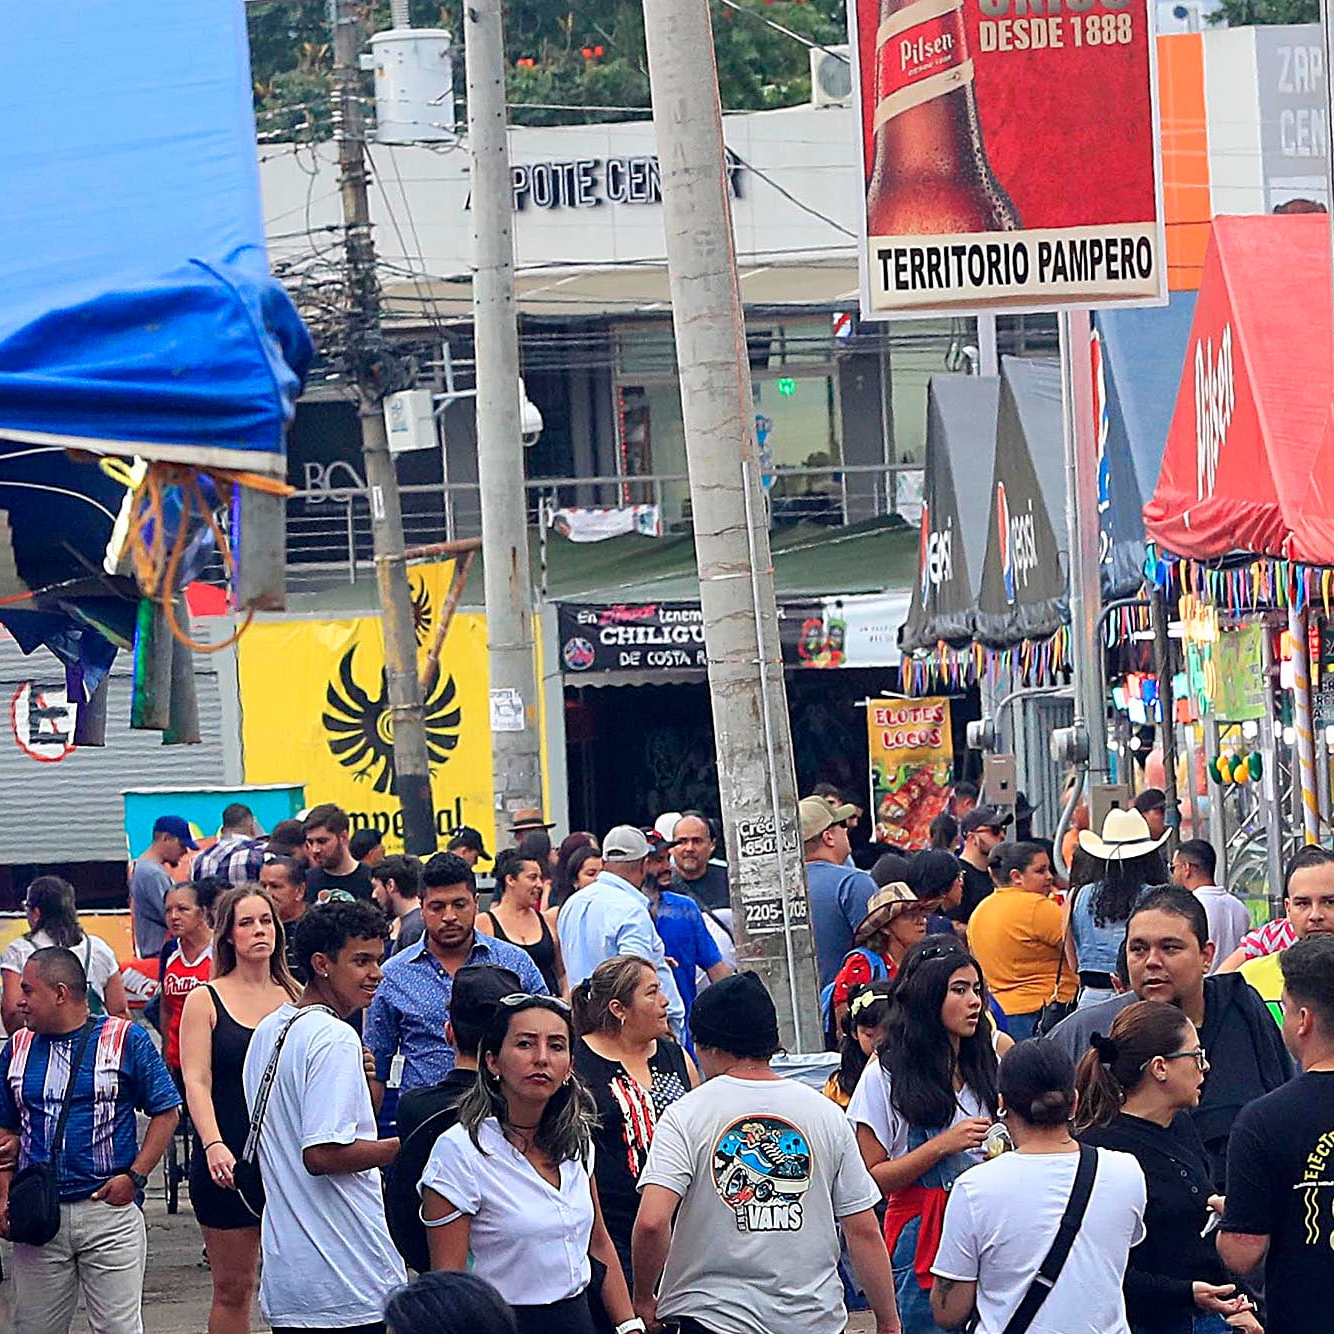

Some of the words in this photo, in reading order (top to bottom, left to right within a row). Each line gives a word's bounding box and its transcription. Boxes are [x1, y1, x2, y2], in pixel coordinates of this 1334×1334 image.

[979, 18, 1063, 52] DESDE
[1070, 13, 1133, 47] 1888
[900, 32, 954, 71] Pilsen
[877, 241, 1029, 291] TERRITORIO
[1038, 236, 1153, 283] PAMPERO
[577, 610, 598, 625] En
[658, 607, 702, 624] tenem
[599, 625, 706, 646] CHILIGU
[619, 651, 641, 667] DE
[647, 650, 691, 667] COSTA
[874, 703, 945, 726] ELOTES
[882, 728, 942, 749] LOCOS
[747, 1202, 803, 1232] VANS
